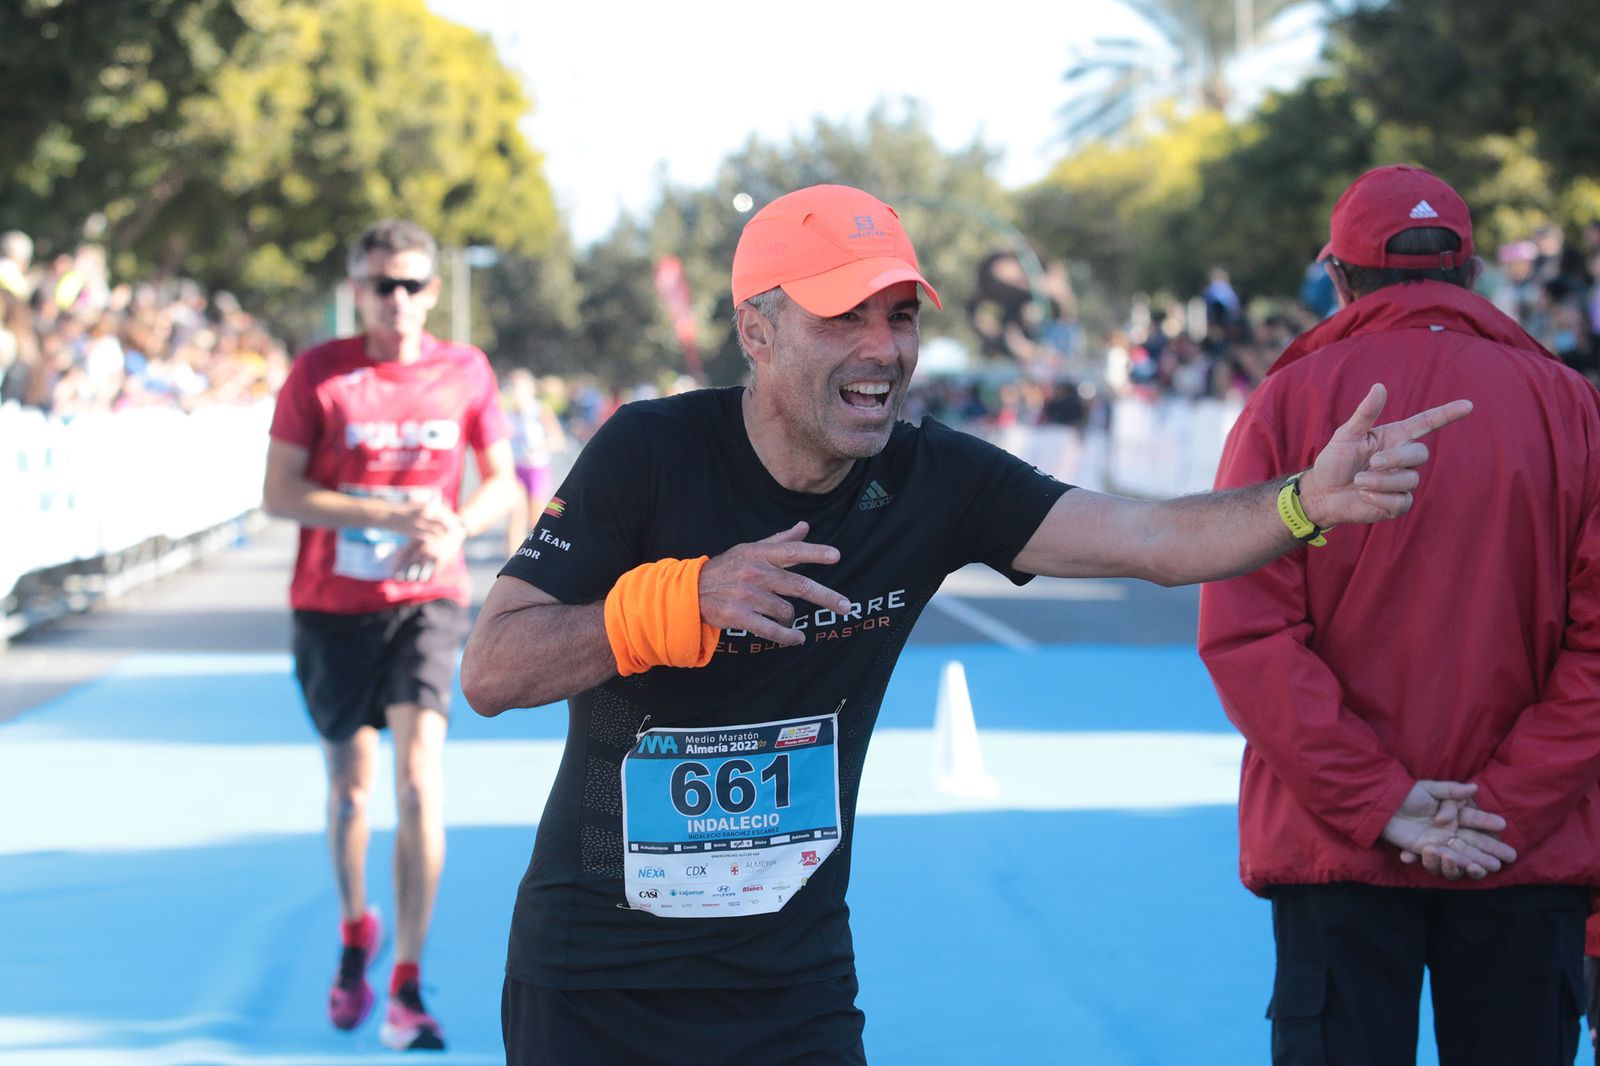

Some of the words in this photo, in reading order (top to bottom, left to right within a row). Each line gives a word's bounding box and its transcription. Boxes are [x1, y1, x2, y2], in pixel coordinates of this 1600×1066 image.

[715, 641, 739, 654] EL
[815, 616, 891, 642] PASTOR
[685, 735, 716, 744] Medio
[718, 731, 759, 742] Maratón
[685, 744, 728, 755] Almería
[669, 753, 791, 817] 661
[687, 813, 780, 833] INDALECIO
[688, 832, 720, 840] INDALECIO
[638, 868, 665, 878] NEXA
[686, 865, 707, 877] CDX
[639, 890, 658, 899] CASI
